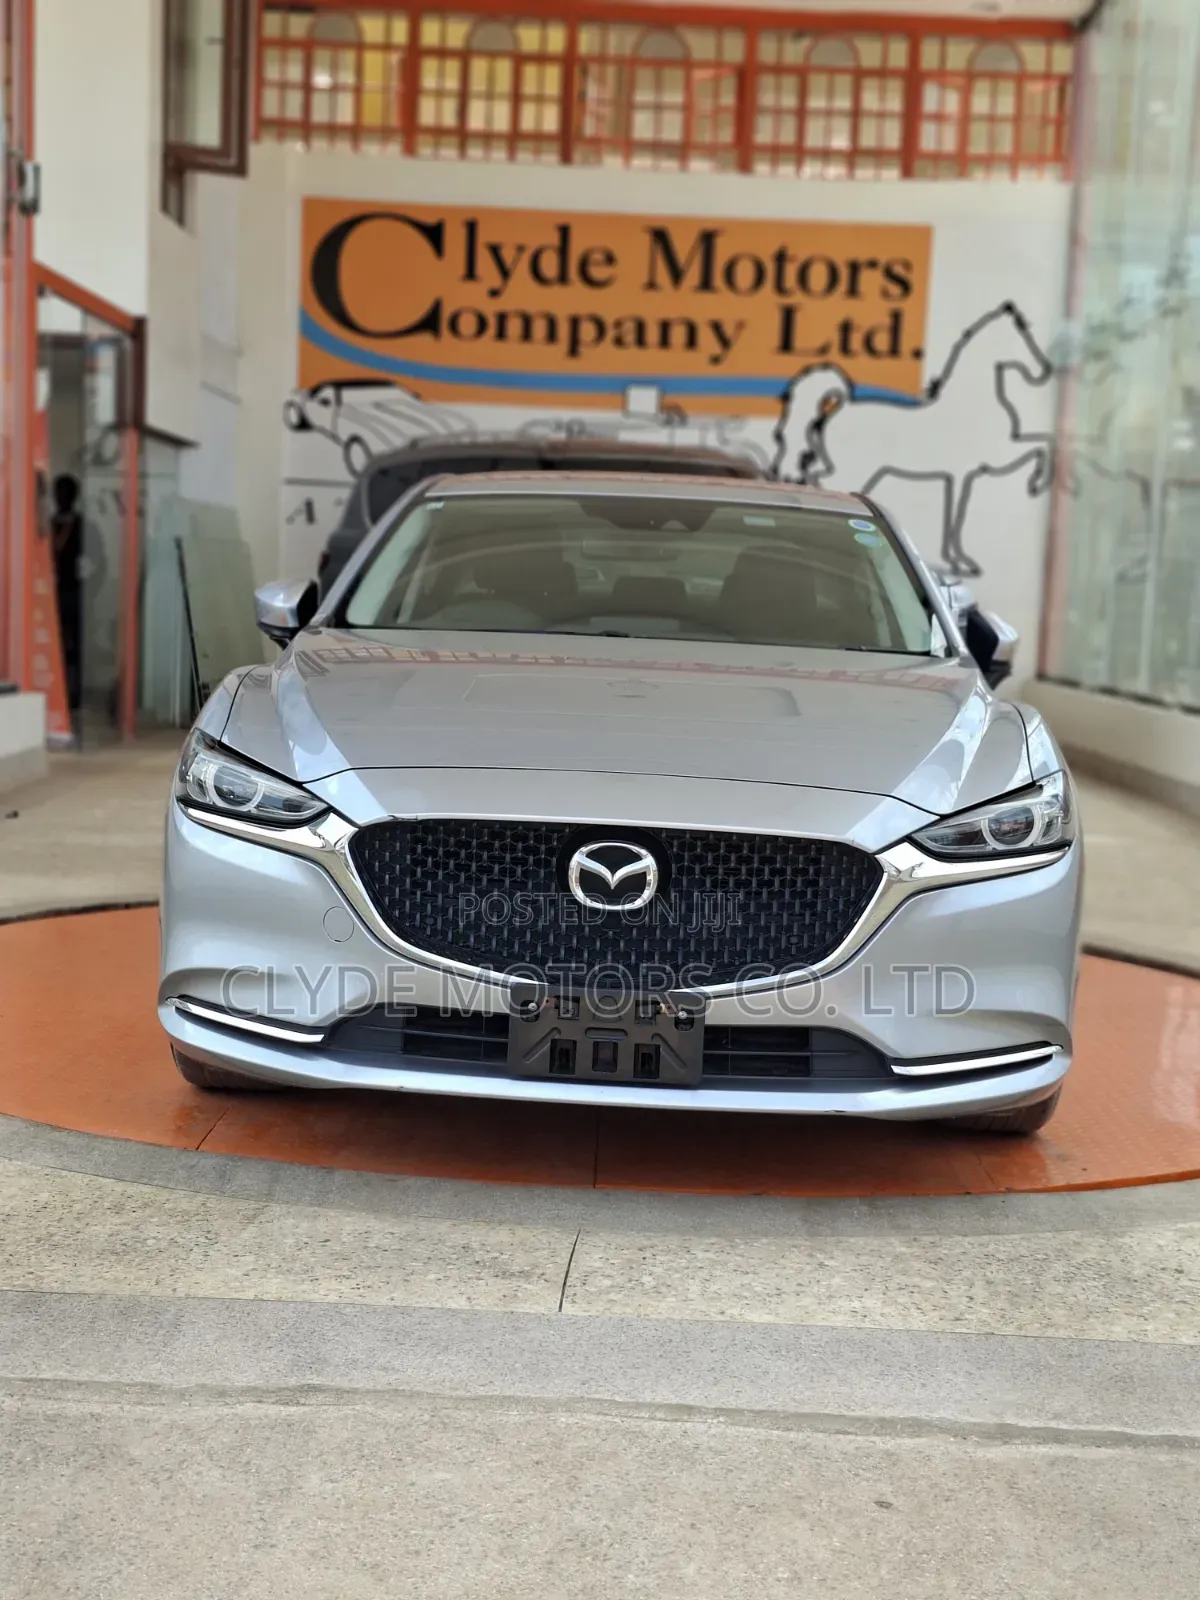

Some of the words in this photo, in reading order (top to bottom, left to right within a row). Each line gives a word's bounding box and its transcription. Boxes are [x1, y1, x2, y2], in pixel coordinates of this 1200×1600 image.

[311, 212, 617, 339] Clyde
[643, 224, 914, 301] Motors
[773, 304, 925, 360] Ltd.
